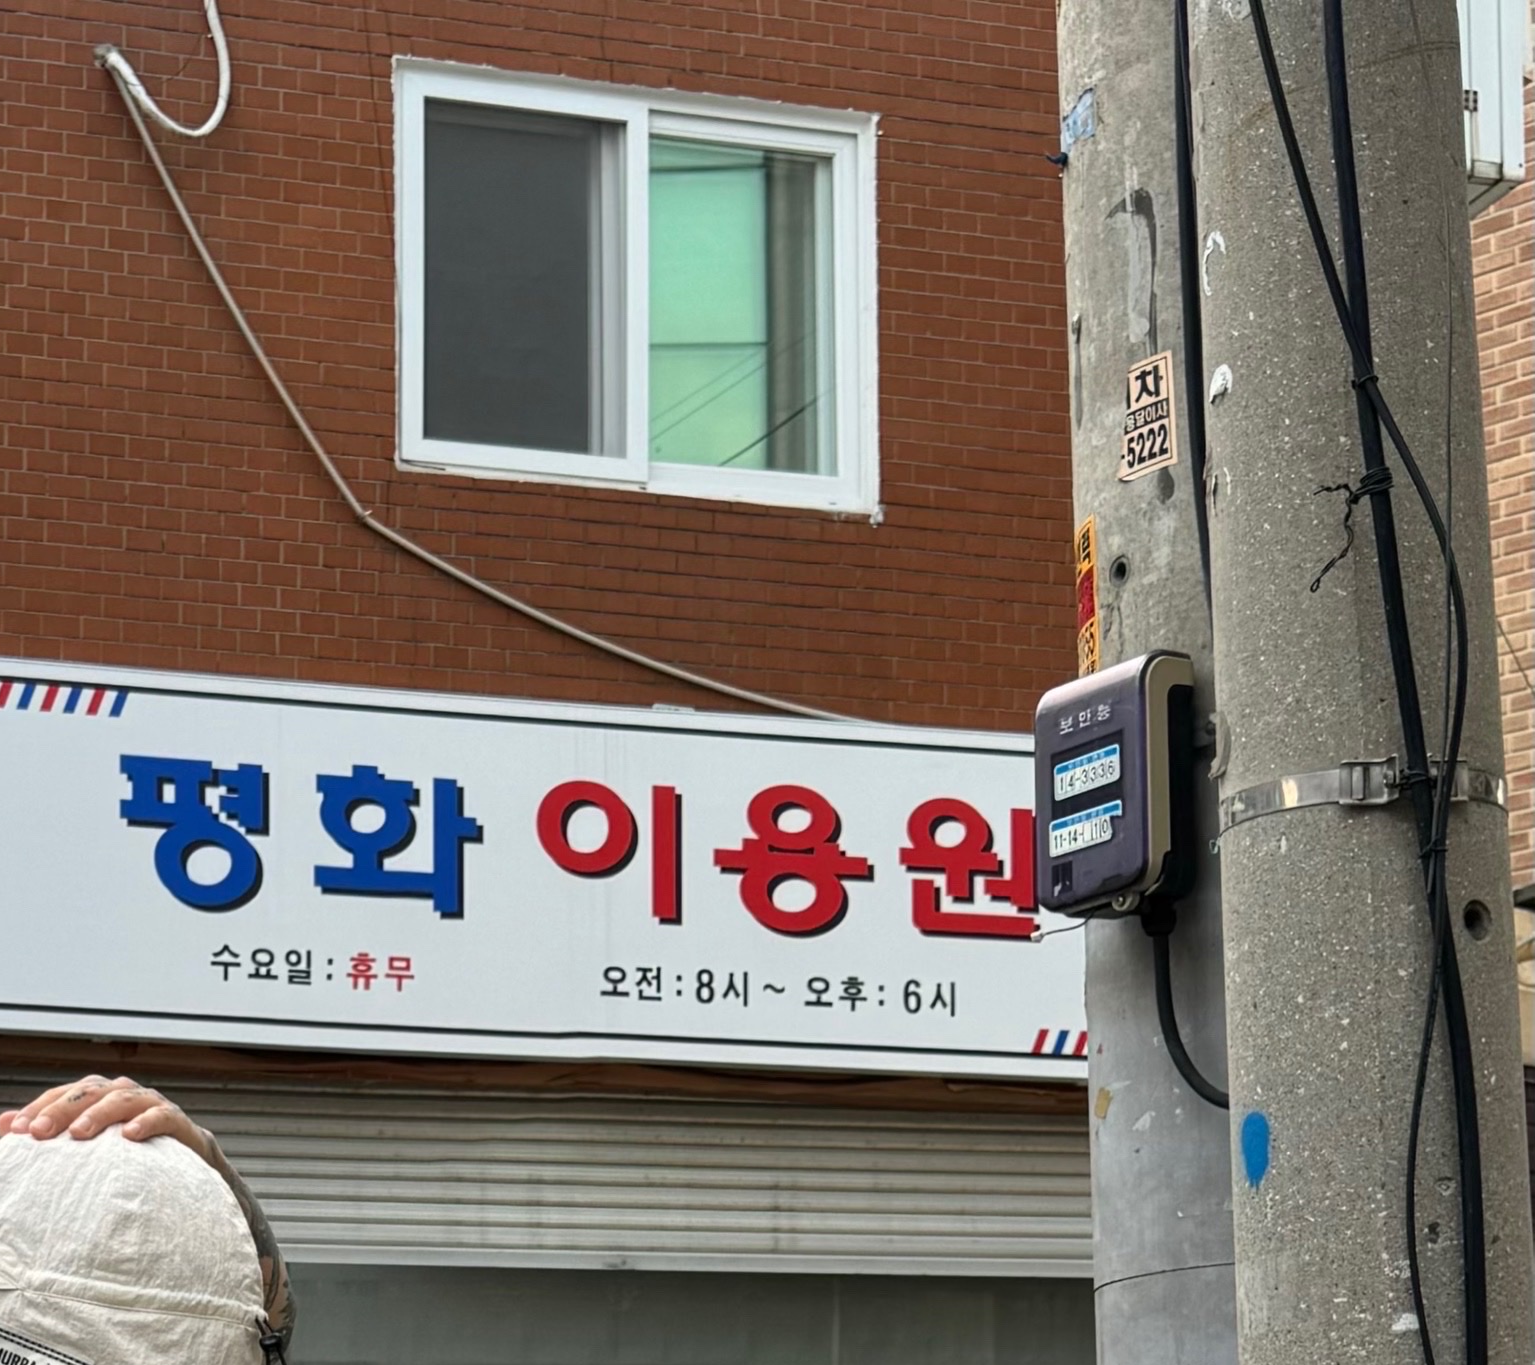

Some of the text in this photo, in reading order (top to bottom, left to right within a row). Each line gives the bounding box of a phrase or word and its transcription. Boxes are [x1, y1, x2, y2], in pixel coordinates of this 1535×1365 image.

[1127, 364, 1163, 409] 차
[1059, 703, 1112, 735] 보안등
[119, 754, 1040, 941] 평화 이용원
